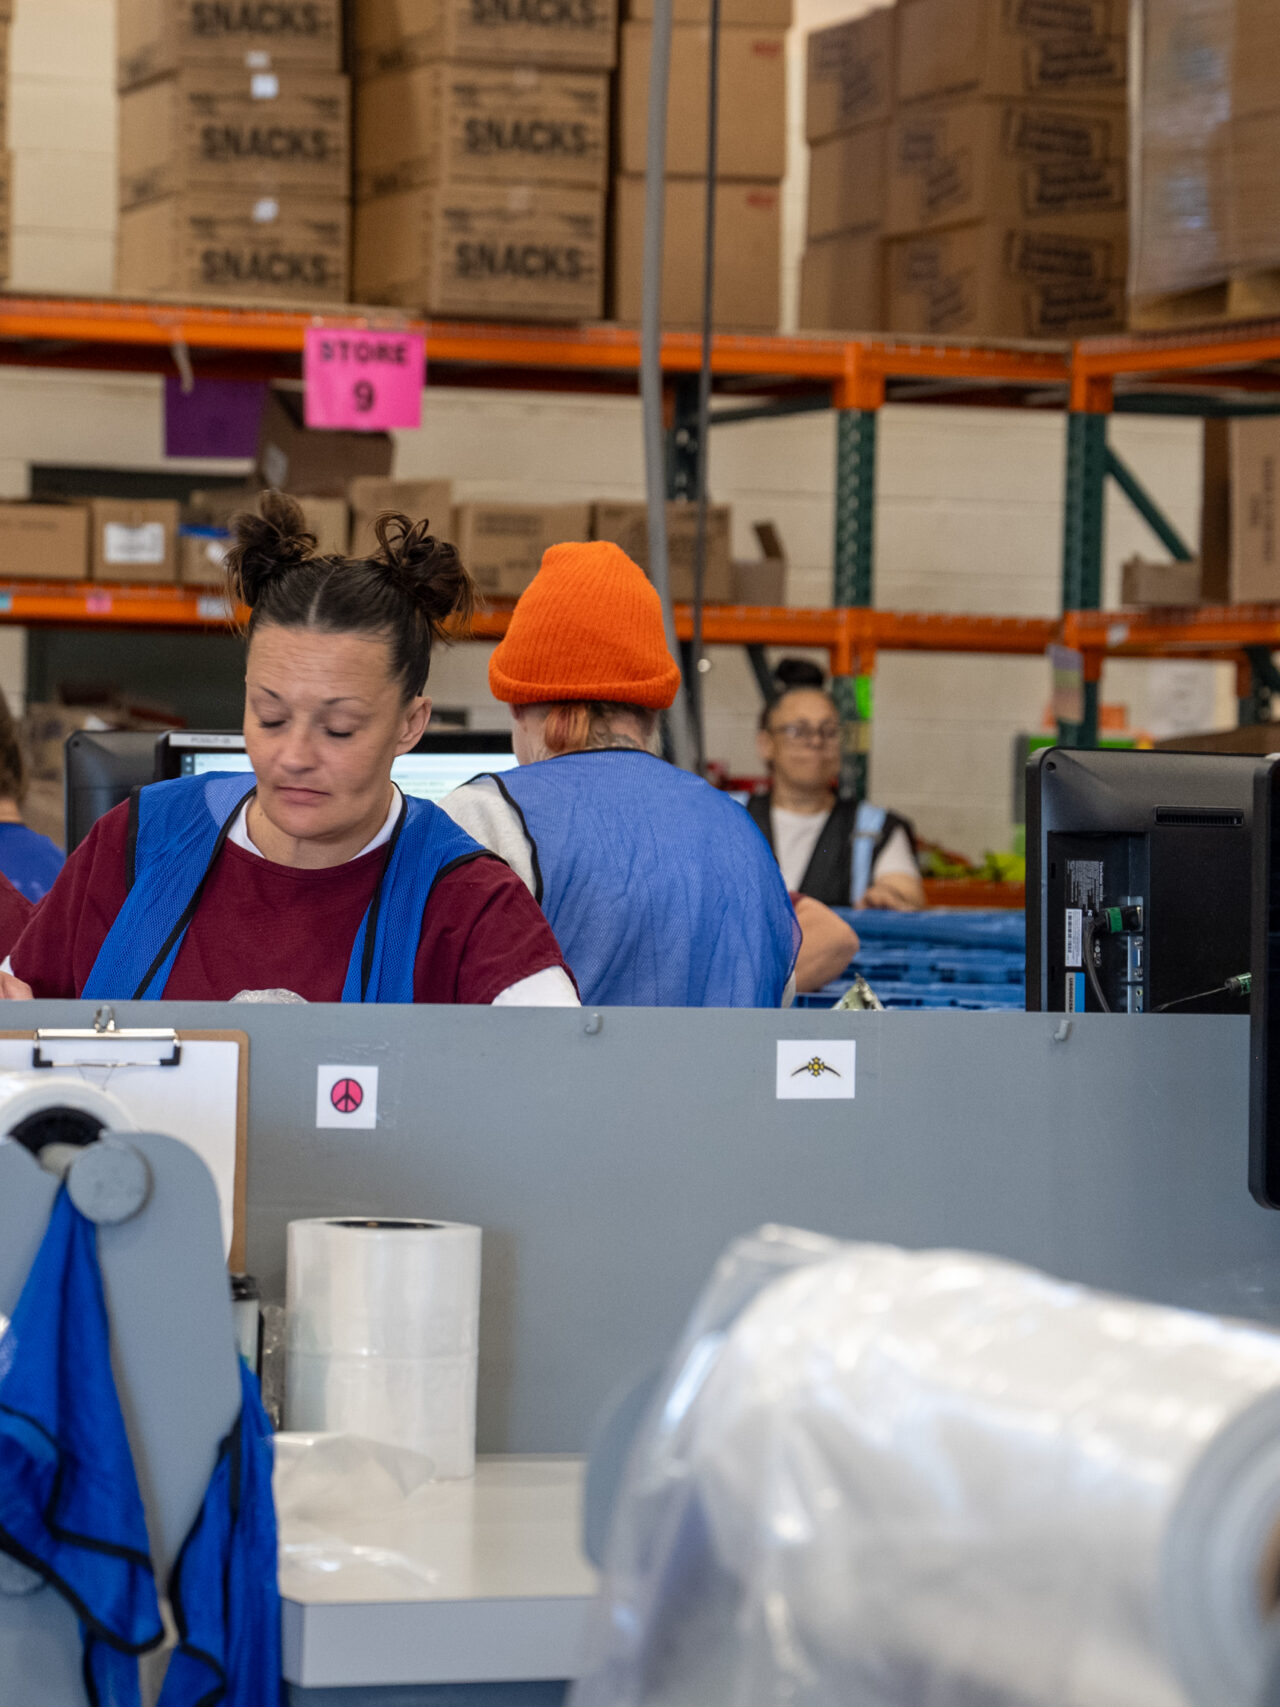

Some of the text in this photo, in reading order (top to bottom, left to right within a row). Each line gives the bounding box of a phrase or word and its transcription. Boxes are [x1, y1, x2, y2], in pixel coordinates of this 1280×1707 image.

[193, 1, 319, 37] SNACKS
[472, 0, 595, 28] SNACKS
[202, 125, 328, 163] SNACKS
[465, 117, 587, 156] SNACKS
[201, 250, 328, 287] SNACKS
[456, 243, 581, 281] SNACKS
[320, 340, 408, 365] STORE
[354, 379, 376, 413] 9
